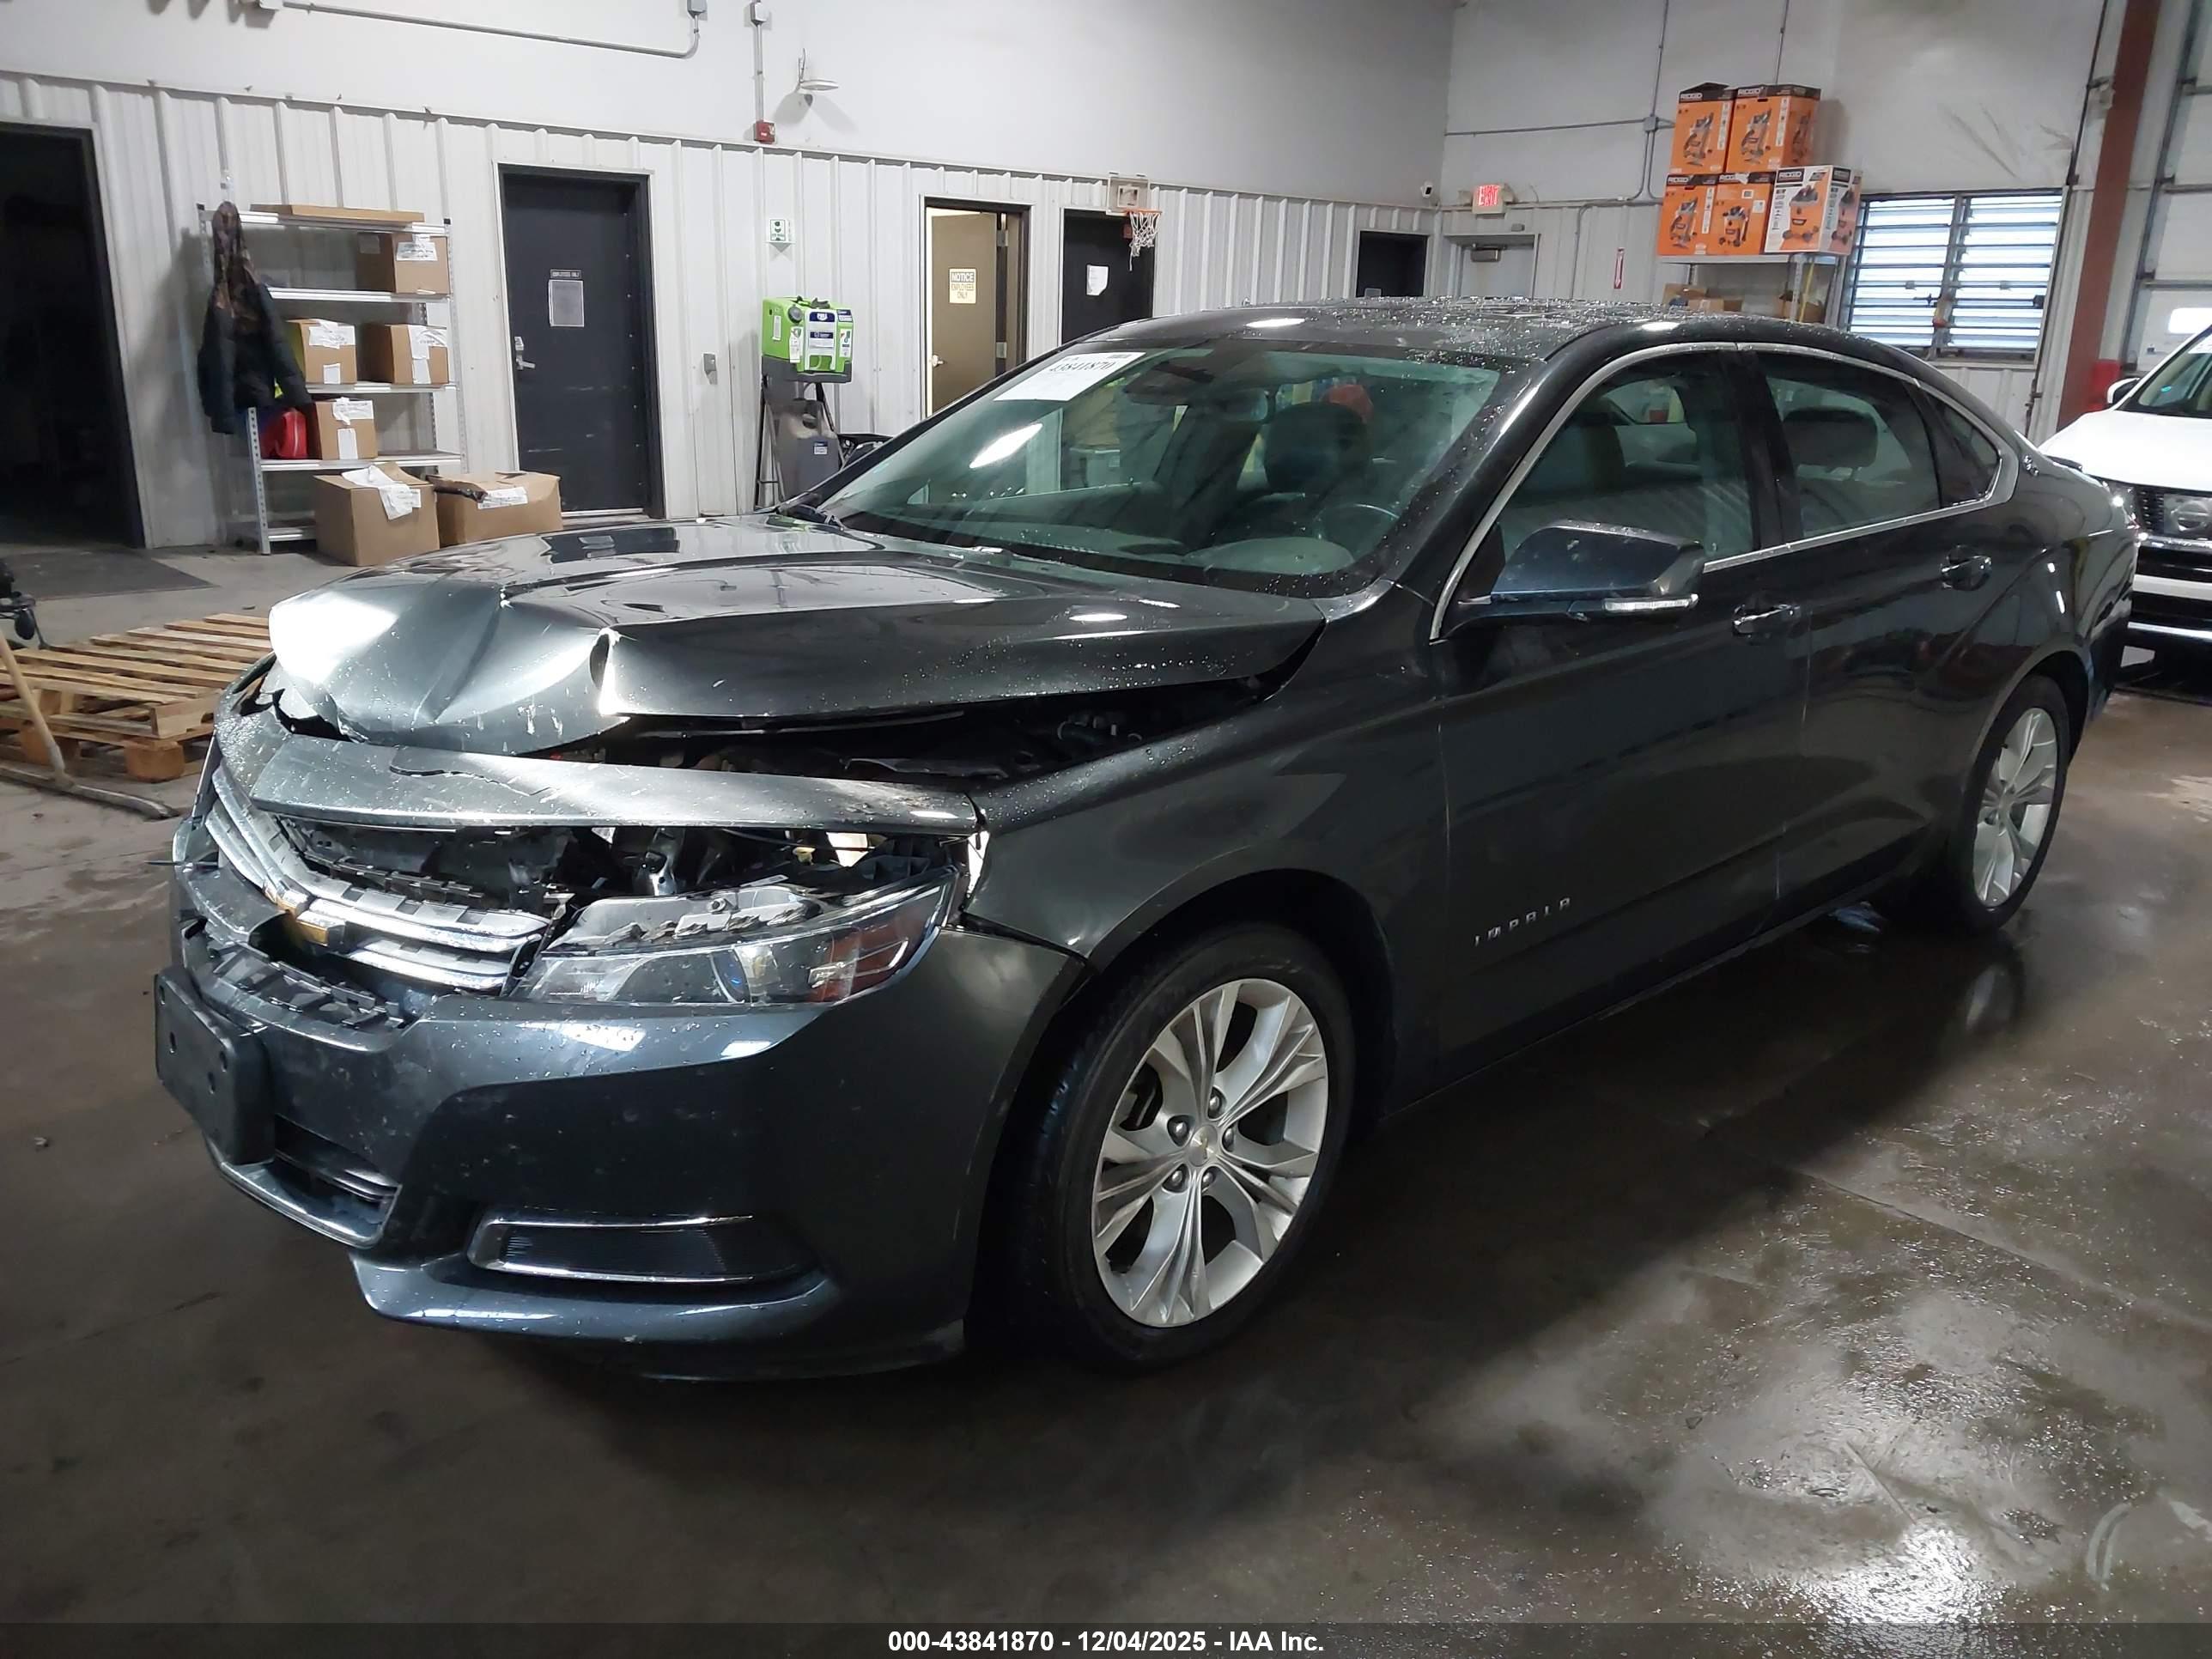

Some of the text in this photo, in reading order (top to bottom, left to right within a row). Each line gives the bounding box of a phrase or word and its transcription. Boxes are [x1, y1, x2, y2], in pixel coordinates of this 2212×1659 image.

[1478, 185, 1499, 206] EXIT
[951, 272, 974, 283] NOTICE
[1474, 897, 1571, 946] IMPALA
